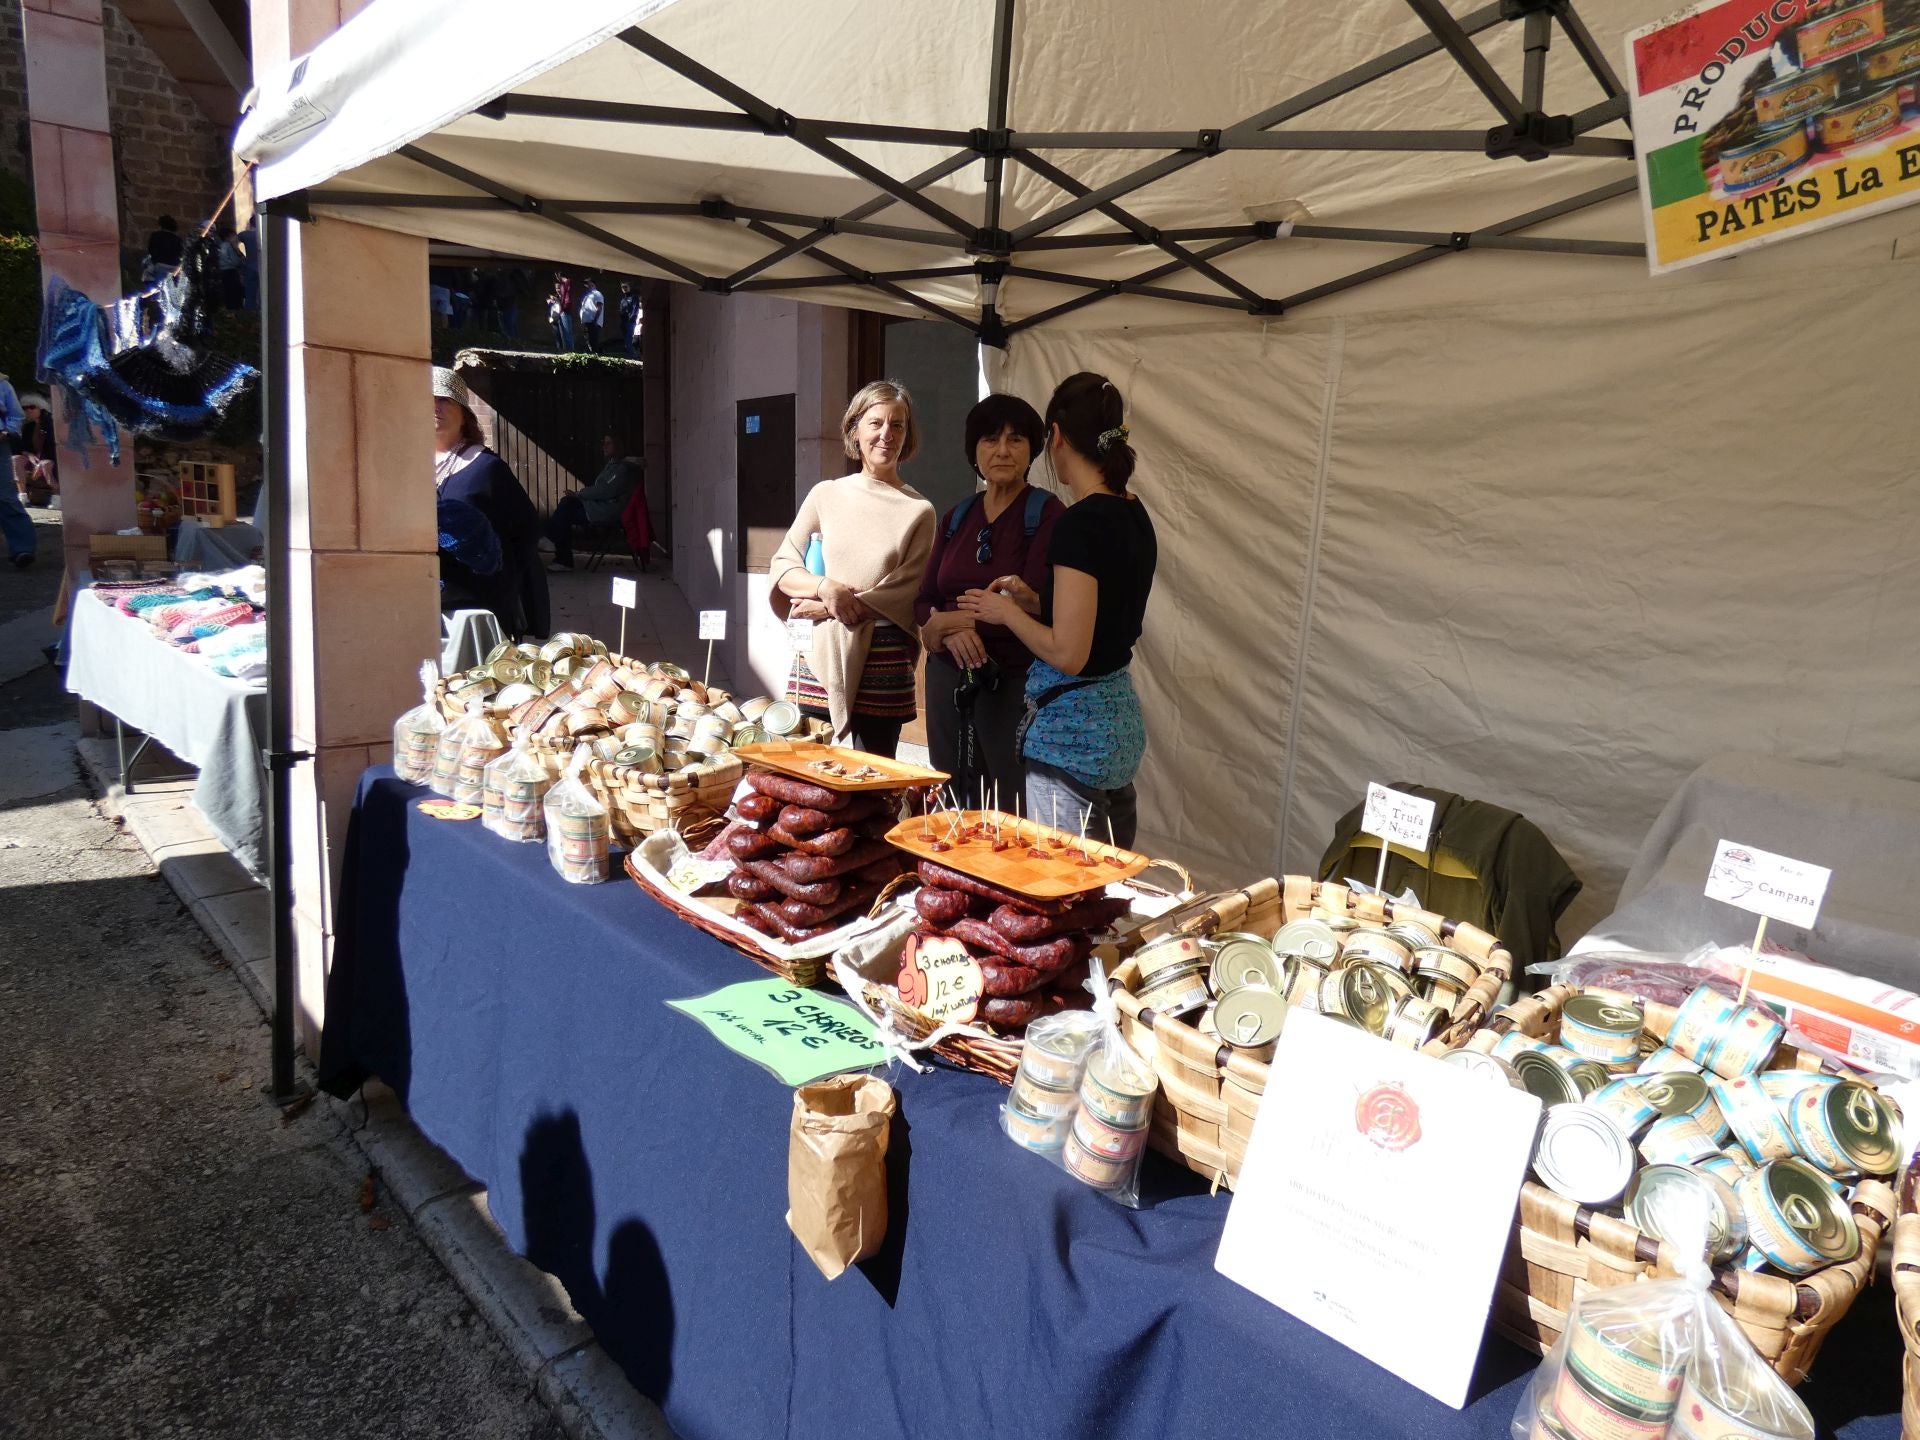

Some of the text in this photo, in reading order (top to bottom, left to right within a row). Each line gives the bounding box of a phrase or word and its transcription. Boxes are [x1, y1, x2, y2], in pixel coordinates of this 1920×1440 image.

[1674, 0, 1822, 134] PRODUC
[1696, 178, 1821, 243] PATÉS
[1834, 166, 1883, 201] La
[1392, 807, 1424, 826] Trufa
[1758, 882, 1815, 906] Campaña
[922, 955, 931, 969] 3
[768, 990, 803, 1003] 3
[763, 1019, 829, 1049] 12 €
